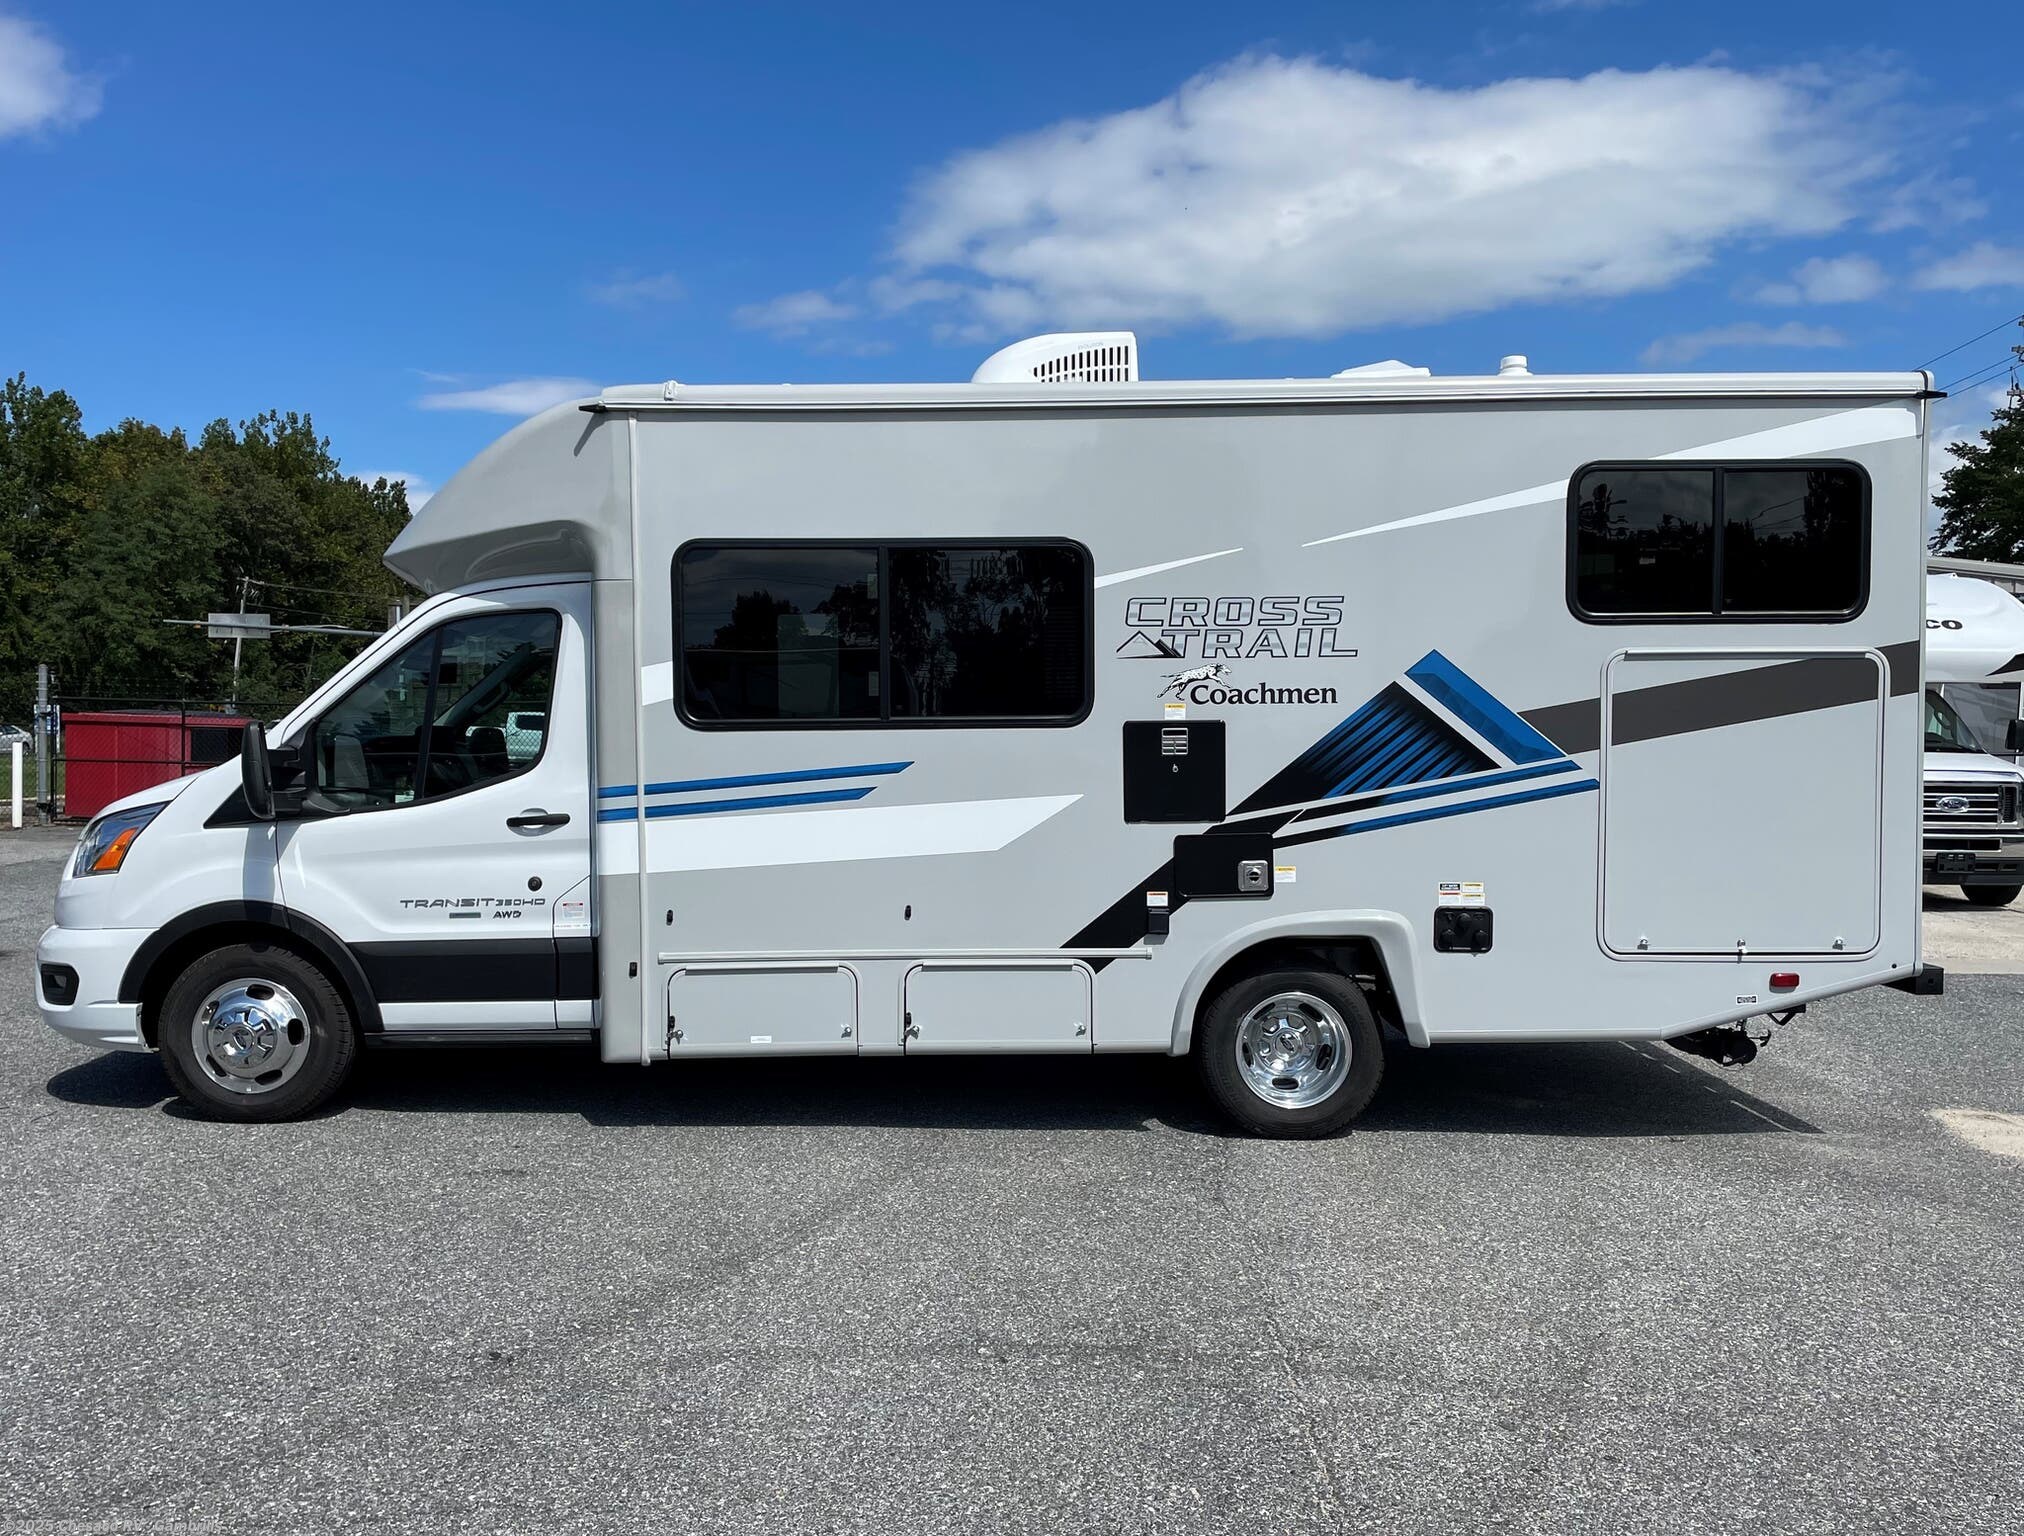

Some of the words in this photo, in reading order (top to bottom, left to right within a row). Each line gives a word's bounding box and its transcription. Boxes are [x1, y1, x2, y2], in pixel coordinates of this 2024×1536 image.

[1125, 595, 1345, 627] CROSS
[1161, 627, 1359, 659] TRAIL
[1190, 682, 1338, 706] Coachmen
[493, 910, 522, 919] AWD
